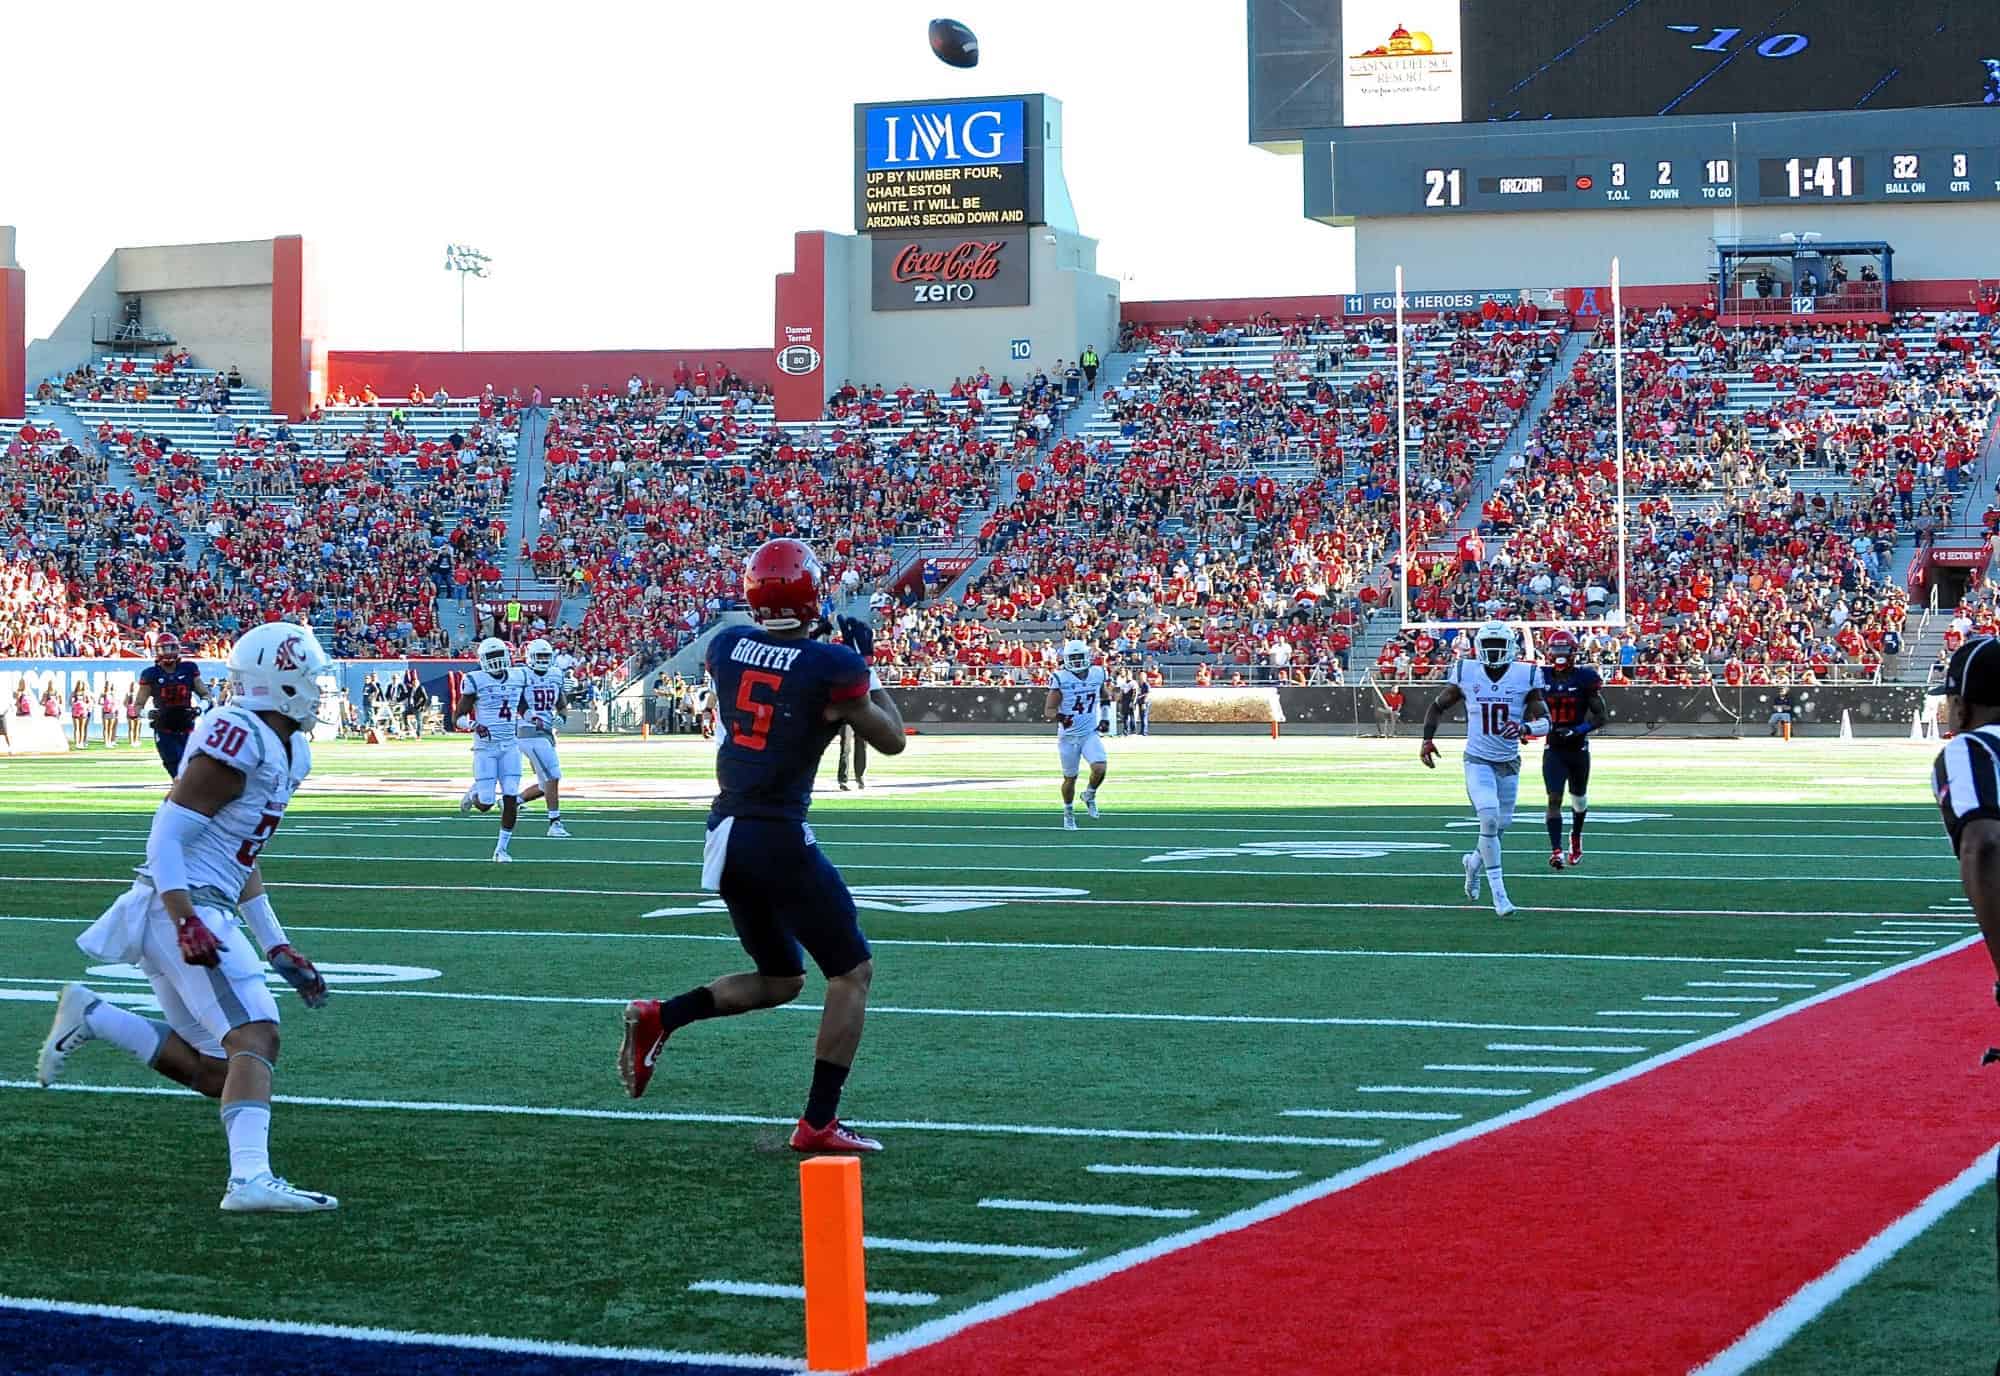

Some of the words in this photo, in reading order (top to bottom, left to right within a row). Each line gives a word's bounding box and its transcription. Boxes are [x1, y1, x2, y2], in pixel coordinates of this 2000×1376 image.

[1350, 61, 1400, 72] CASINO
[1402, 58, 1425, 70] DEL
[1376, 72, 1423, 83] RESORT
[884, 111, 1005, 163] IMG
[1611, 162, 1626, 187] 3
[1657, 160, 1672, 186] 2
[1705, 159, 1730, 184] 10
[1892, 154, 1919, 179] 32
[1952, 153, 1967, 178] 3
[866, 171, 884, 184] UP
[887, 169, 904, 183] BY
[907, 168, 960, 182] NUMBER
[964, 166, 1002, 180] FOUR,
[1785, 156, 1853, 198] 1:41
[866, 184, 951, 198] CHARLESTON
[1425, 169, 1461, 208] 21
[1499, 178, 1543, 193] ARIZONA
[1650, 188, 1679, 200] DOWN
[1702, 188, 1715, 199] TO
[1717, 187, 1732, 198] GO
[1886, 182, 1908, 194] BALL
[1910, 182, 1926, 193] ON
[1950, 181, 1970, 193] QTR
[913, 199, 924, 211] IT
[928, 198, 959, 211] WILL
[963, 197, 981, 209] BE
[866, 213, 921, 228] ARIZONA'S
[923, 212, 965, 226] SECOND
[967, 211, 999, 224] DOWN
[1001, 209, 1024, 222] AND
[914, 284, 974, 302] zero
[1414, 293, 1474, 308] HEROES
[1347, 297, 1363, 312] 11
[1793, 300, 1812, 313] 12
[785, 326, 813, 334] Damon
[1012, 341, 1031, 357] 10
[1947, 551, 1973, 560] SECTION
[730, 637, 802, 671] GRIFFEY
[498, 699, 512, 721] 4
[732, 669, 784, 751] 5
[1071, 693, 1096, 714] 47
[1480, 702, 1509, 736] 10
[207, 718, 248, 757] 30
